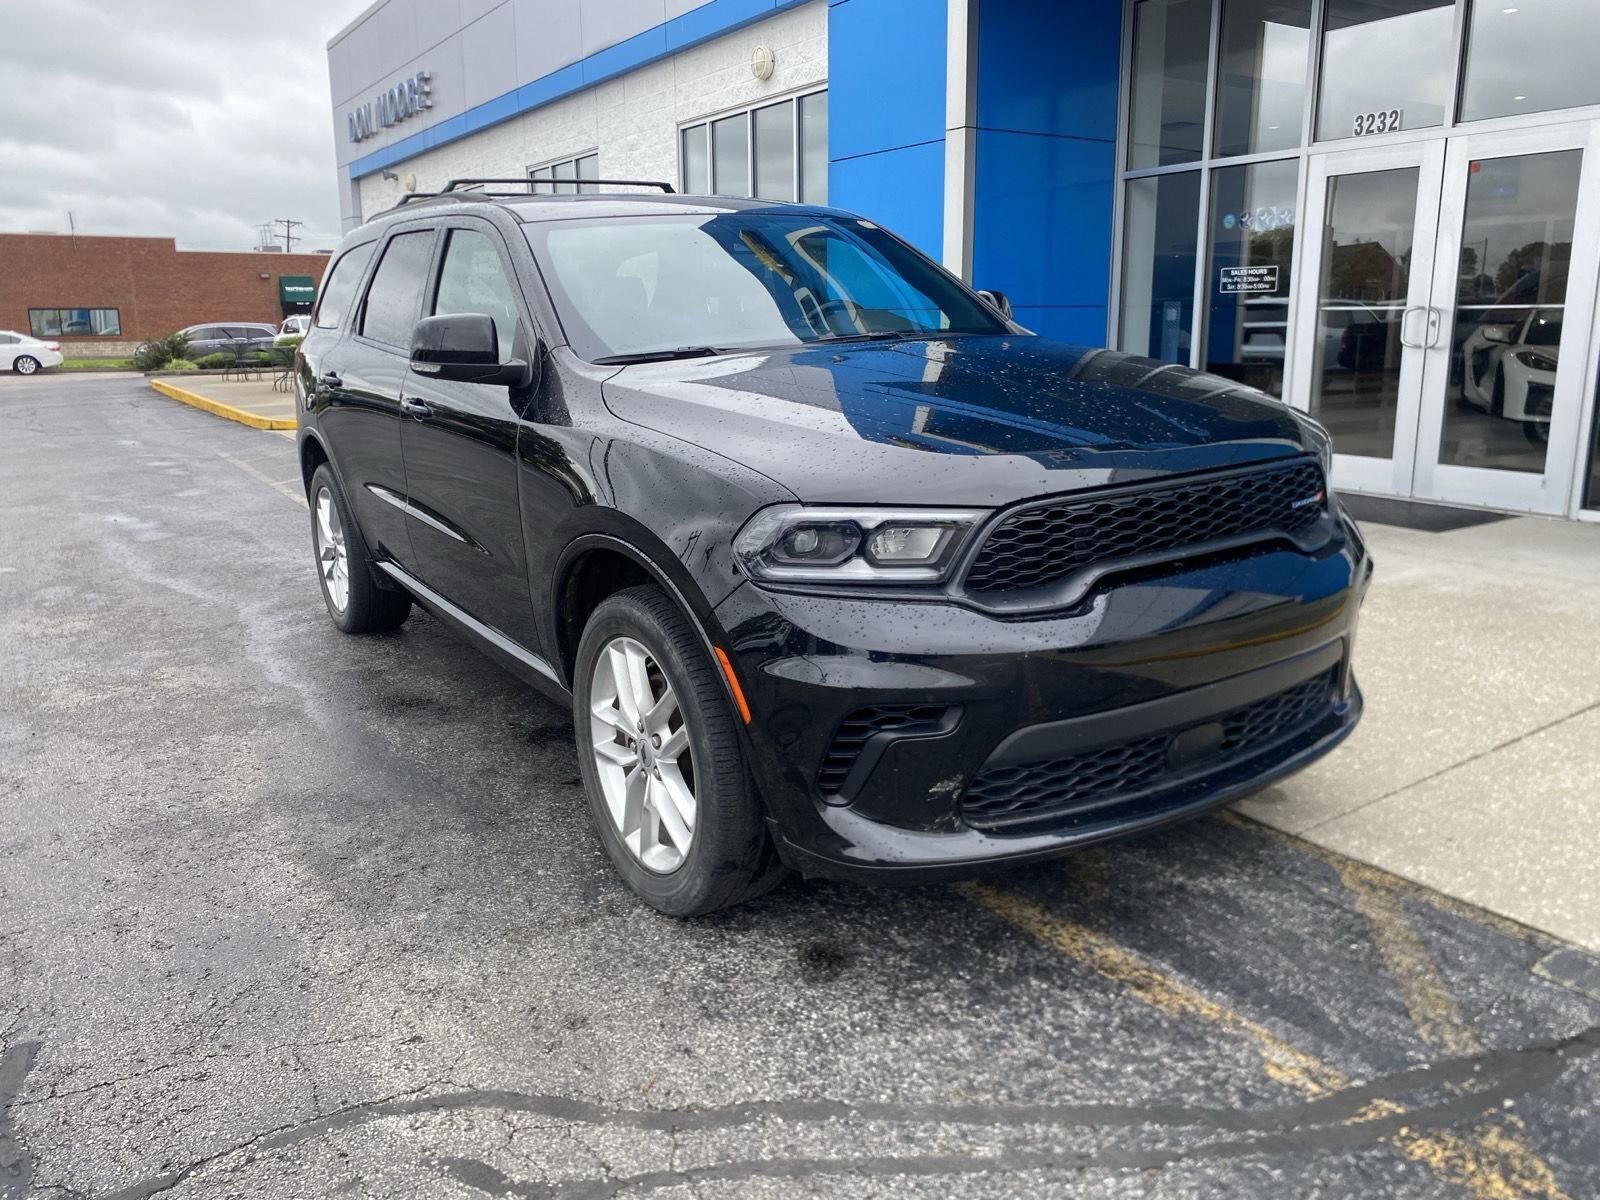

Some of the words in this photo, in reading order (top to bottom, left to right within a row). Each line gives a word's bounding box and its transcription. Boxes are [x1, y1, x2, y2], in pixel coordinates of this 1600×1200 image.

[347, 103, 377, 142] DON
[376, 71, 431, 128] MOORE
[1354, 110, 1399, 136] 3232
